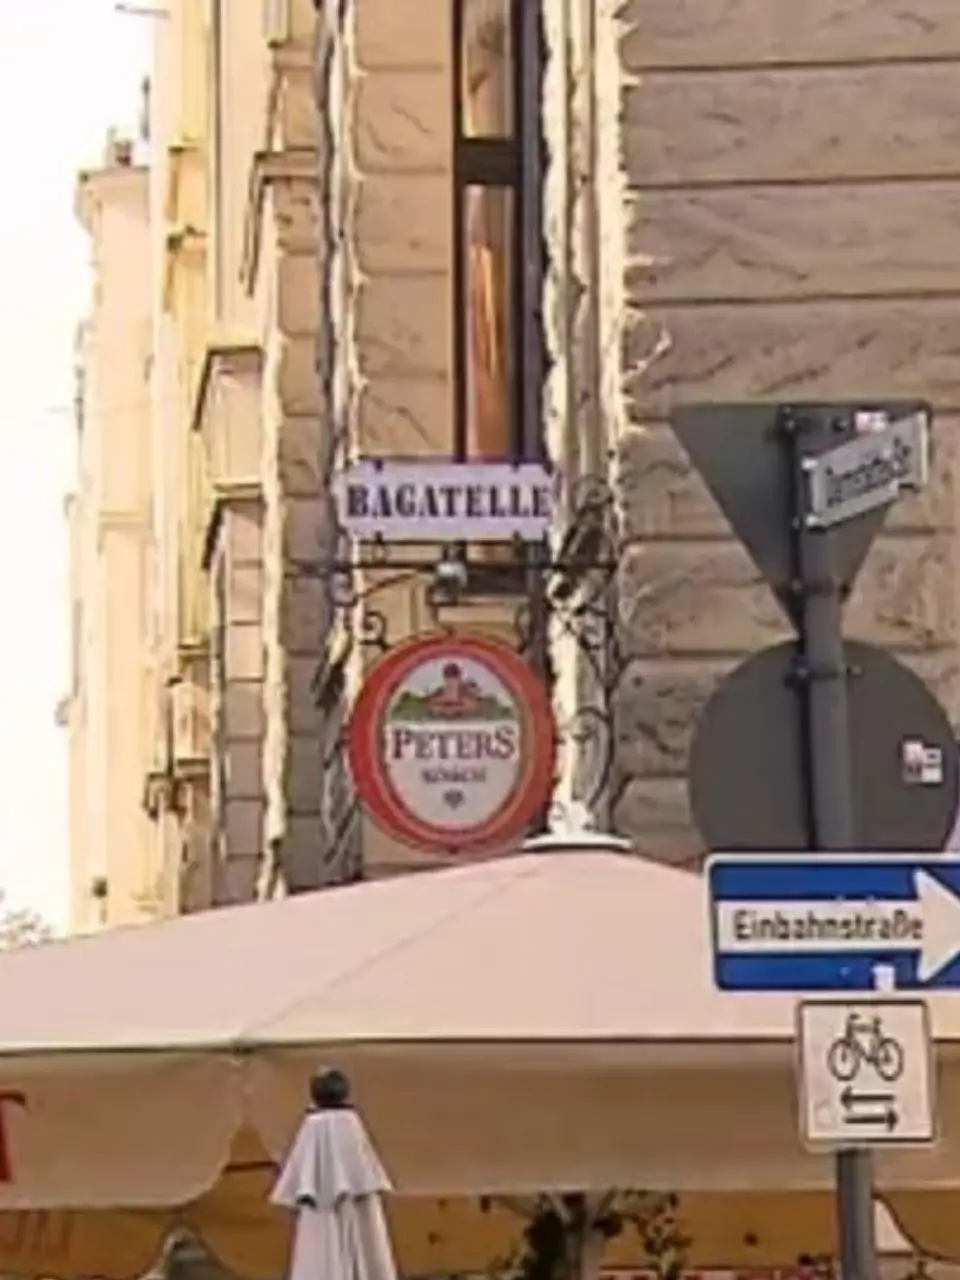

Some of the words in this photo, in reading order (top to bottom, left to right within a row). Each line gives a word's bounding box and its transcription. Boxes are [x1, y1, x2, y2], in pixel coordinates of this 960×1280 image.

[347, 484, 551, 518] BAGATELLE
[392, 725, 516, 760] PETERS
[732, 908, 924, 941] Einbahnstraße
